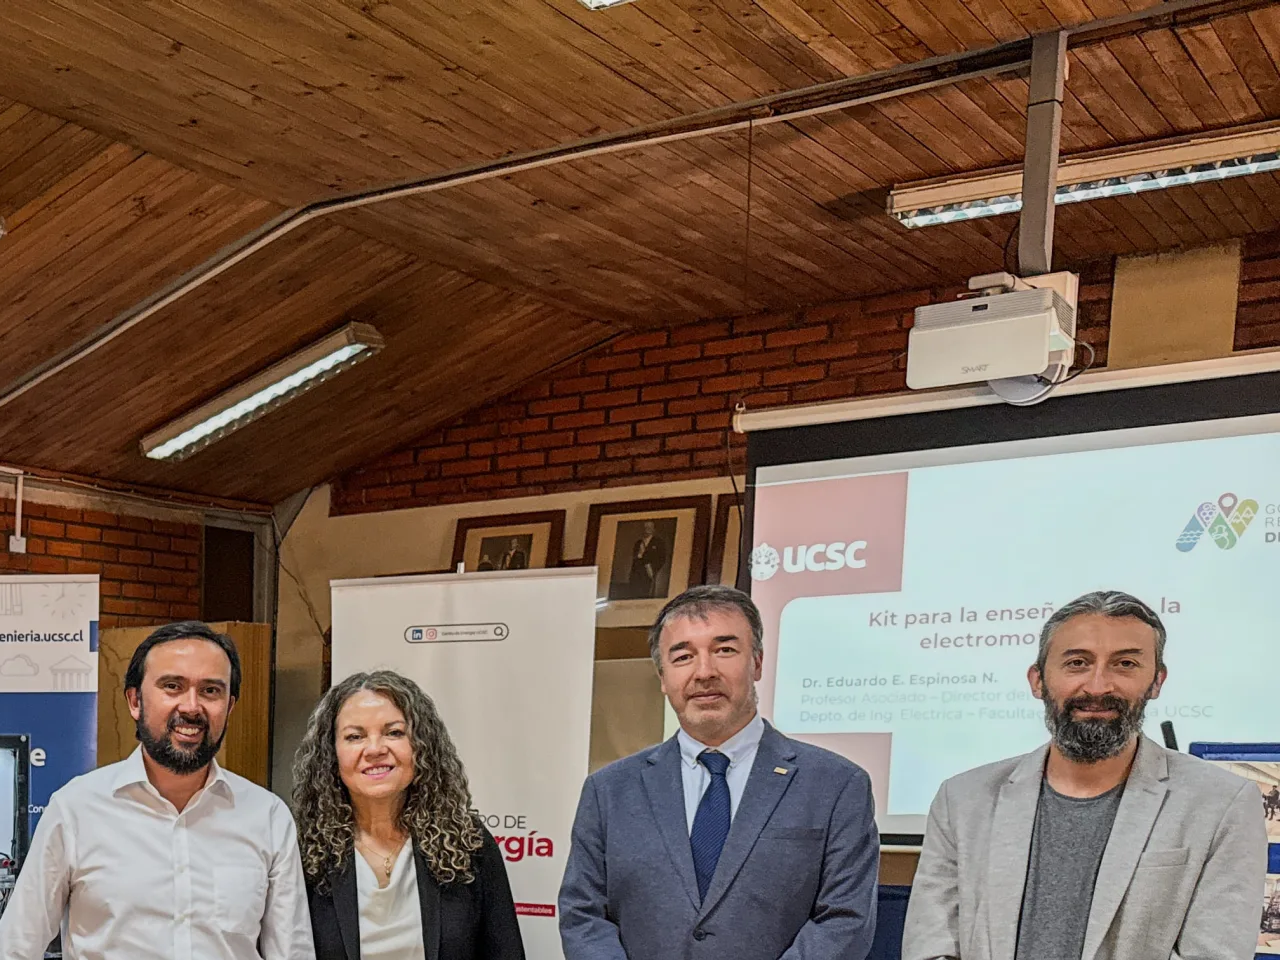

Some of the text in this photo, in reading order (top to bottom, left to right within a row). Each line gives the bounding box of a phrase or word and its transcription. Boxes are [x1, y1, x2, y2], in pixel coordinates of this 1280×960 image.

[783, 540, 867, 573] UCSC
[869, 597, 1181, 629] Kit para la enseñ la
[920, 632, 1038, 649] electromo
[802, 672, 998, 689] Dr. Eduardo E. Espinosa N.
[848, 709, 866, 722] de
[1164, 704, 1214, 718] UCSC
[28, 804, 45, 813] Con
[504, 815, 527, 829] DE
[493, 830, 554, 862] rgía
